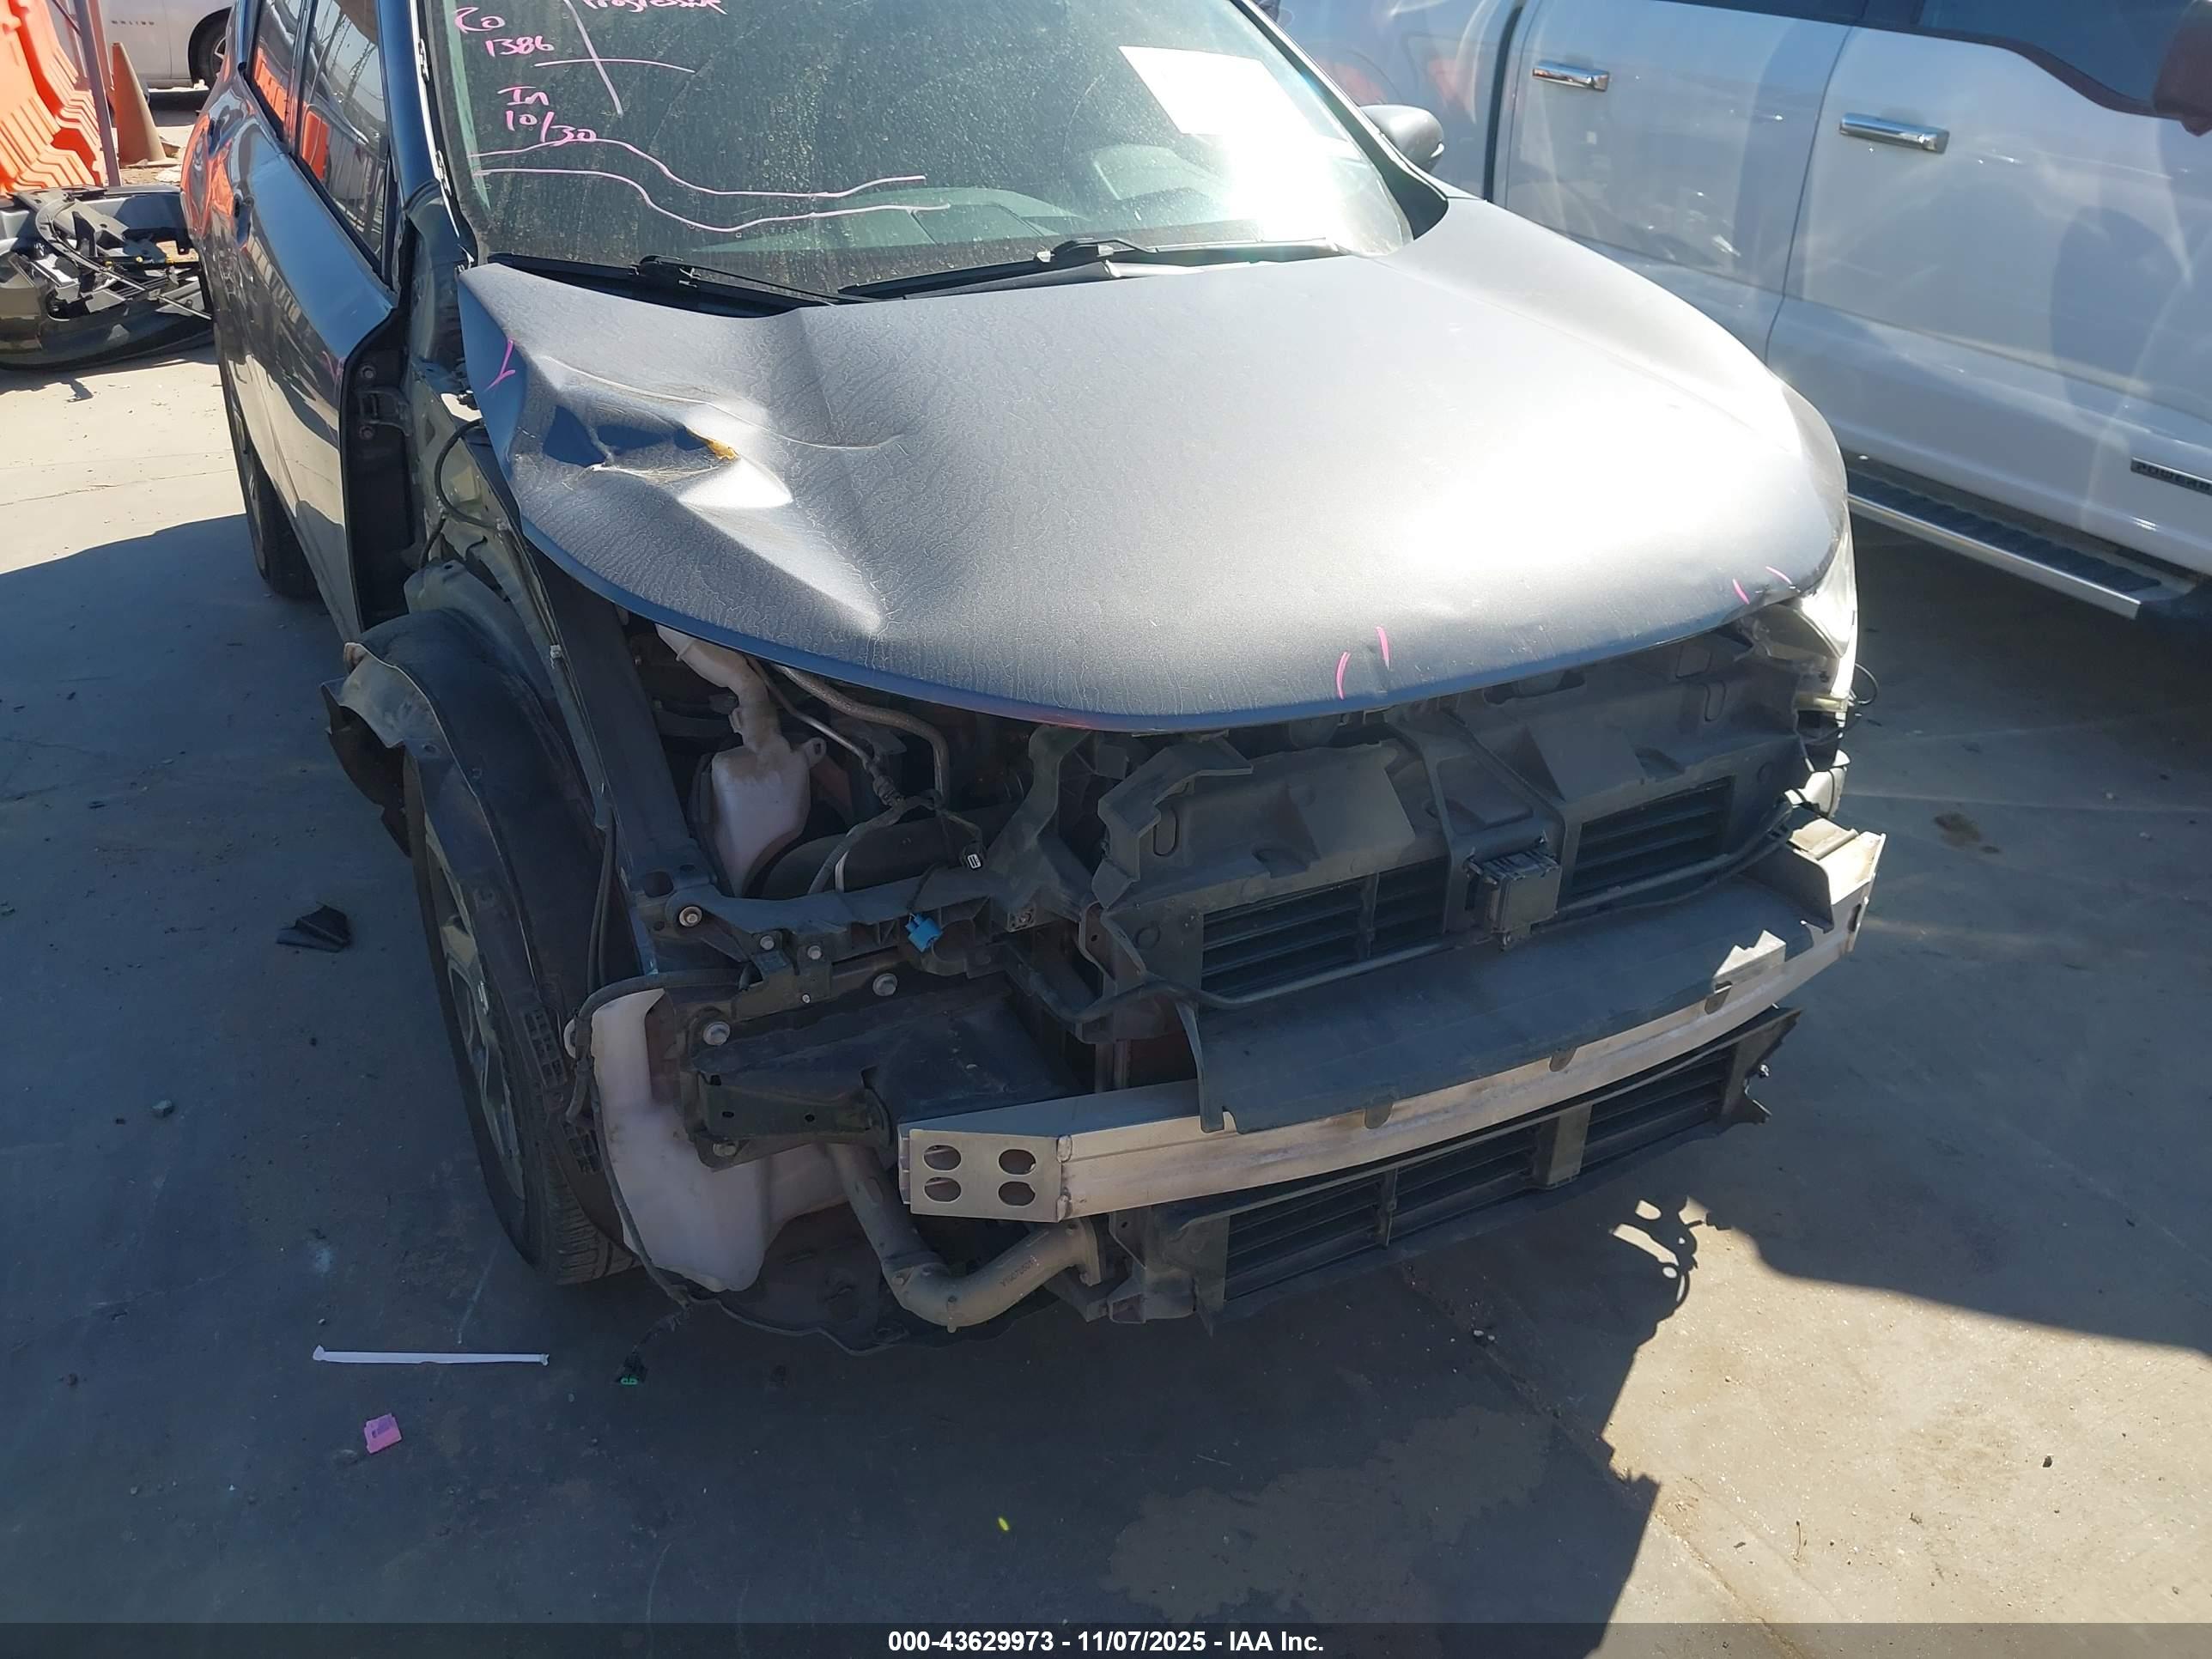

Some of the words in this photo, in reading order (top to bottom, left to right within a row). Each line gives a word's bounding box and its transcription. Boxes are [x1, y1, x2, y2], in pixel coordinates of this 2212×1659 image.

[485, 35, 555, 58] 1386
[496, 86, 550, 106] In
[505, 110, 598, 147] 10/30
